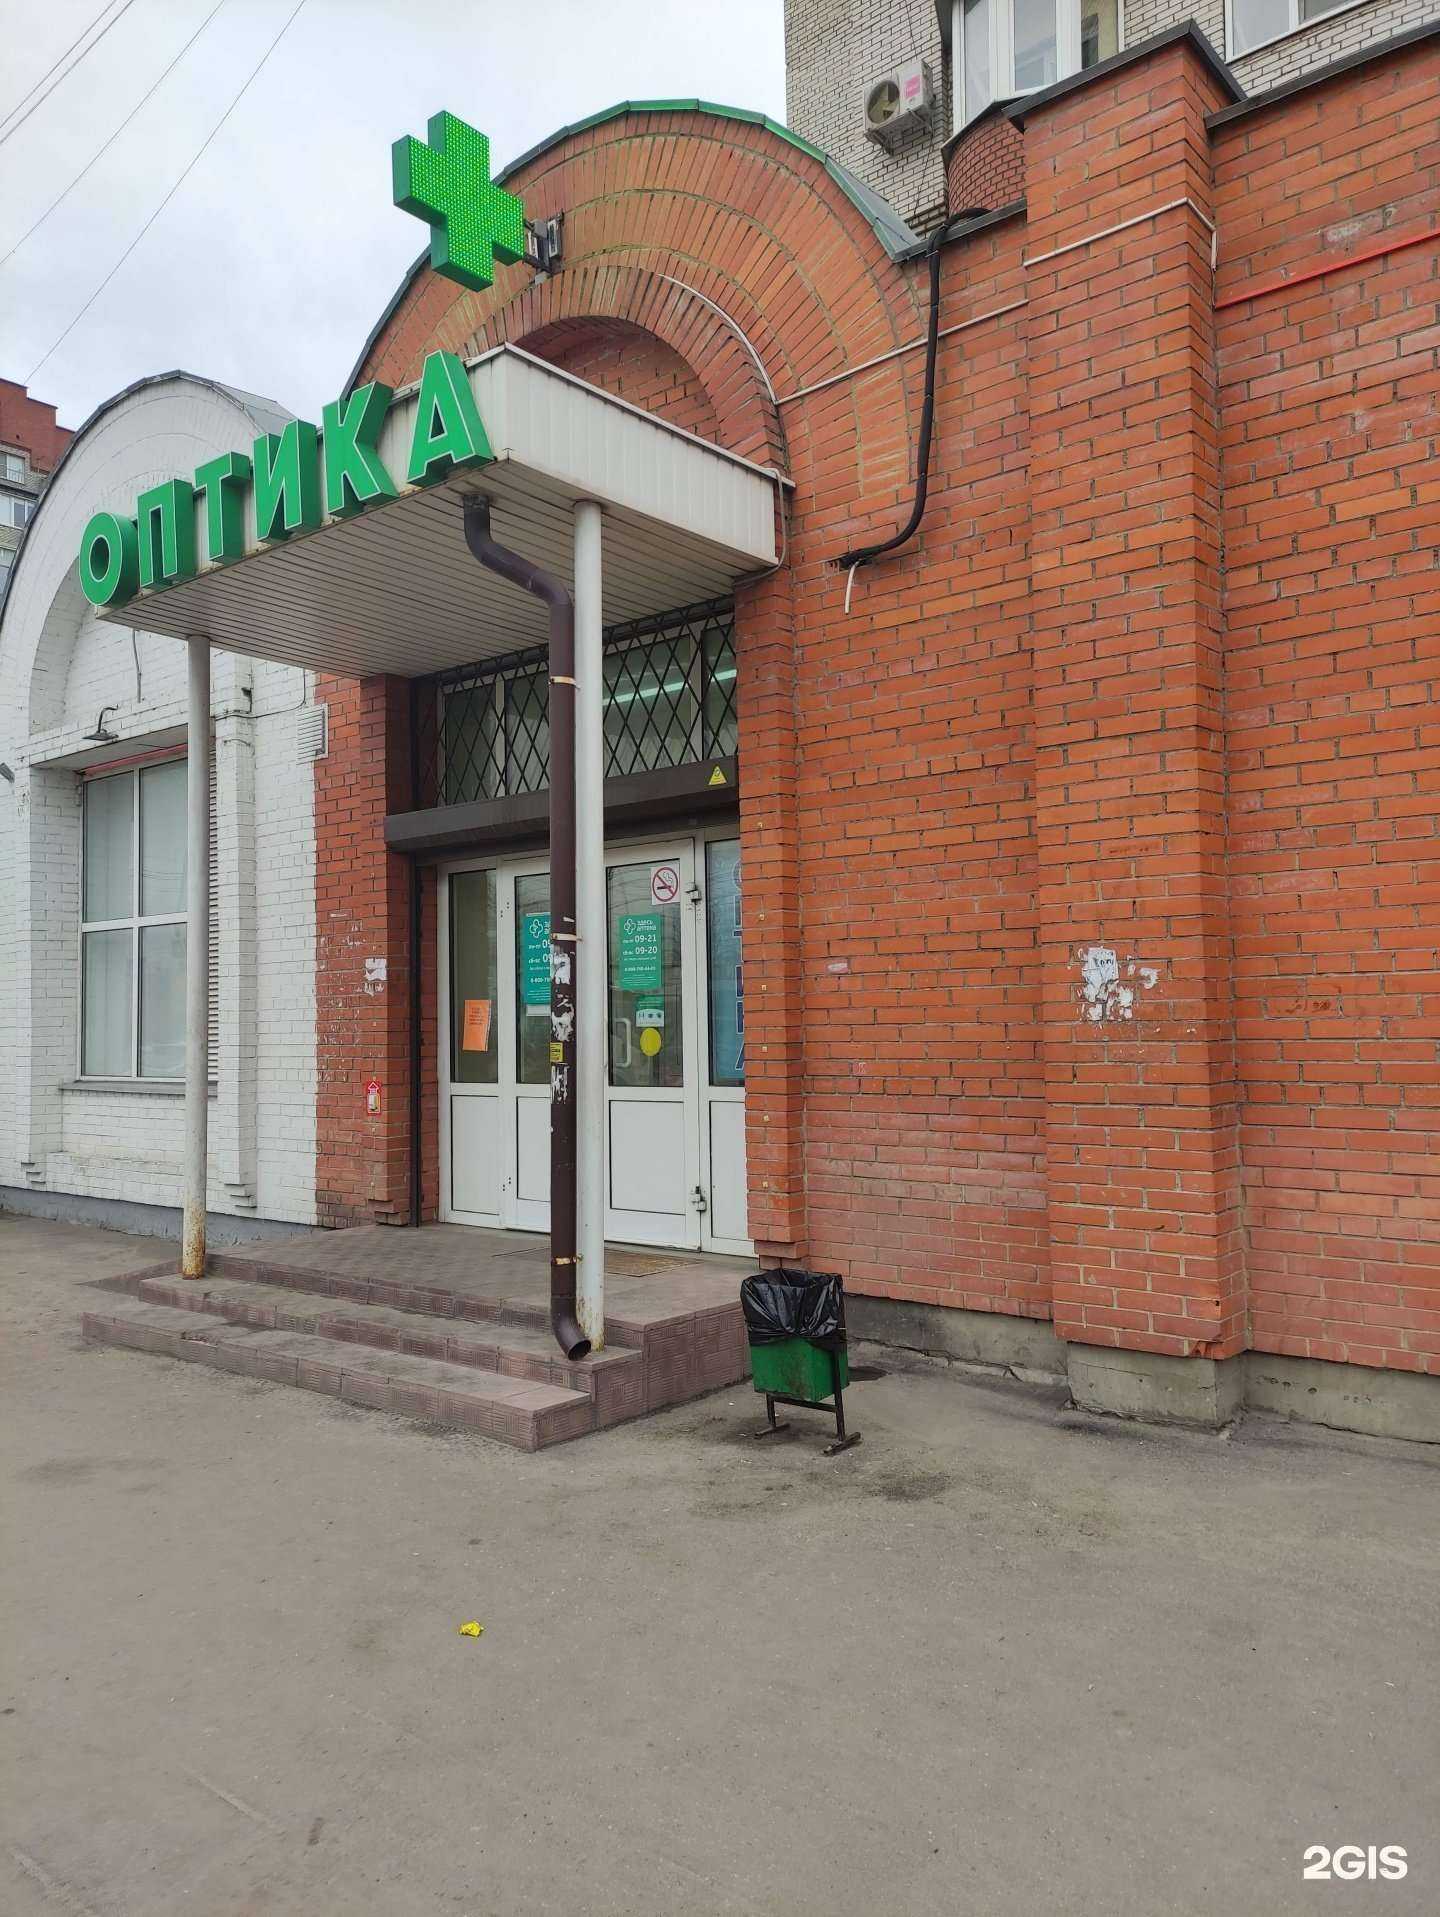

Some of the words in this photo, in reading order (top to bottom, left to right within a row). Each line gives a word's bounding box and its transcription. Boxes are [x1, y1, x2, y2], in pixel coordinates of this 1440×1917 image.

[79, 349, 497, 607] ОПТИКА
[634, 934, 657, 943] 09-21
[635, 946, 658, 955] 09-20
